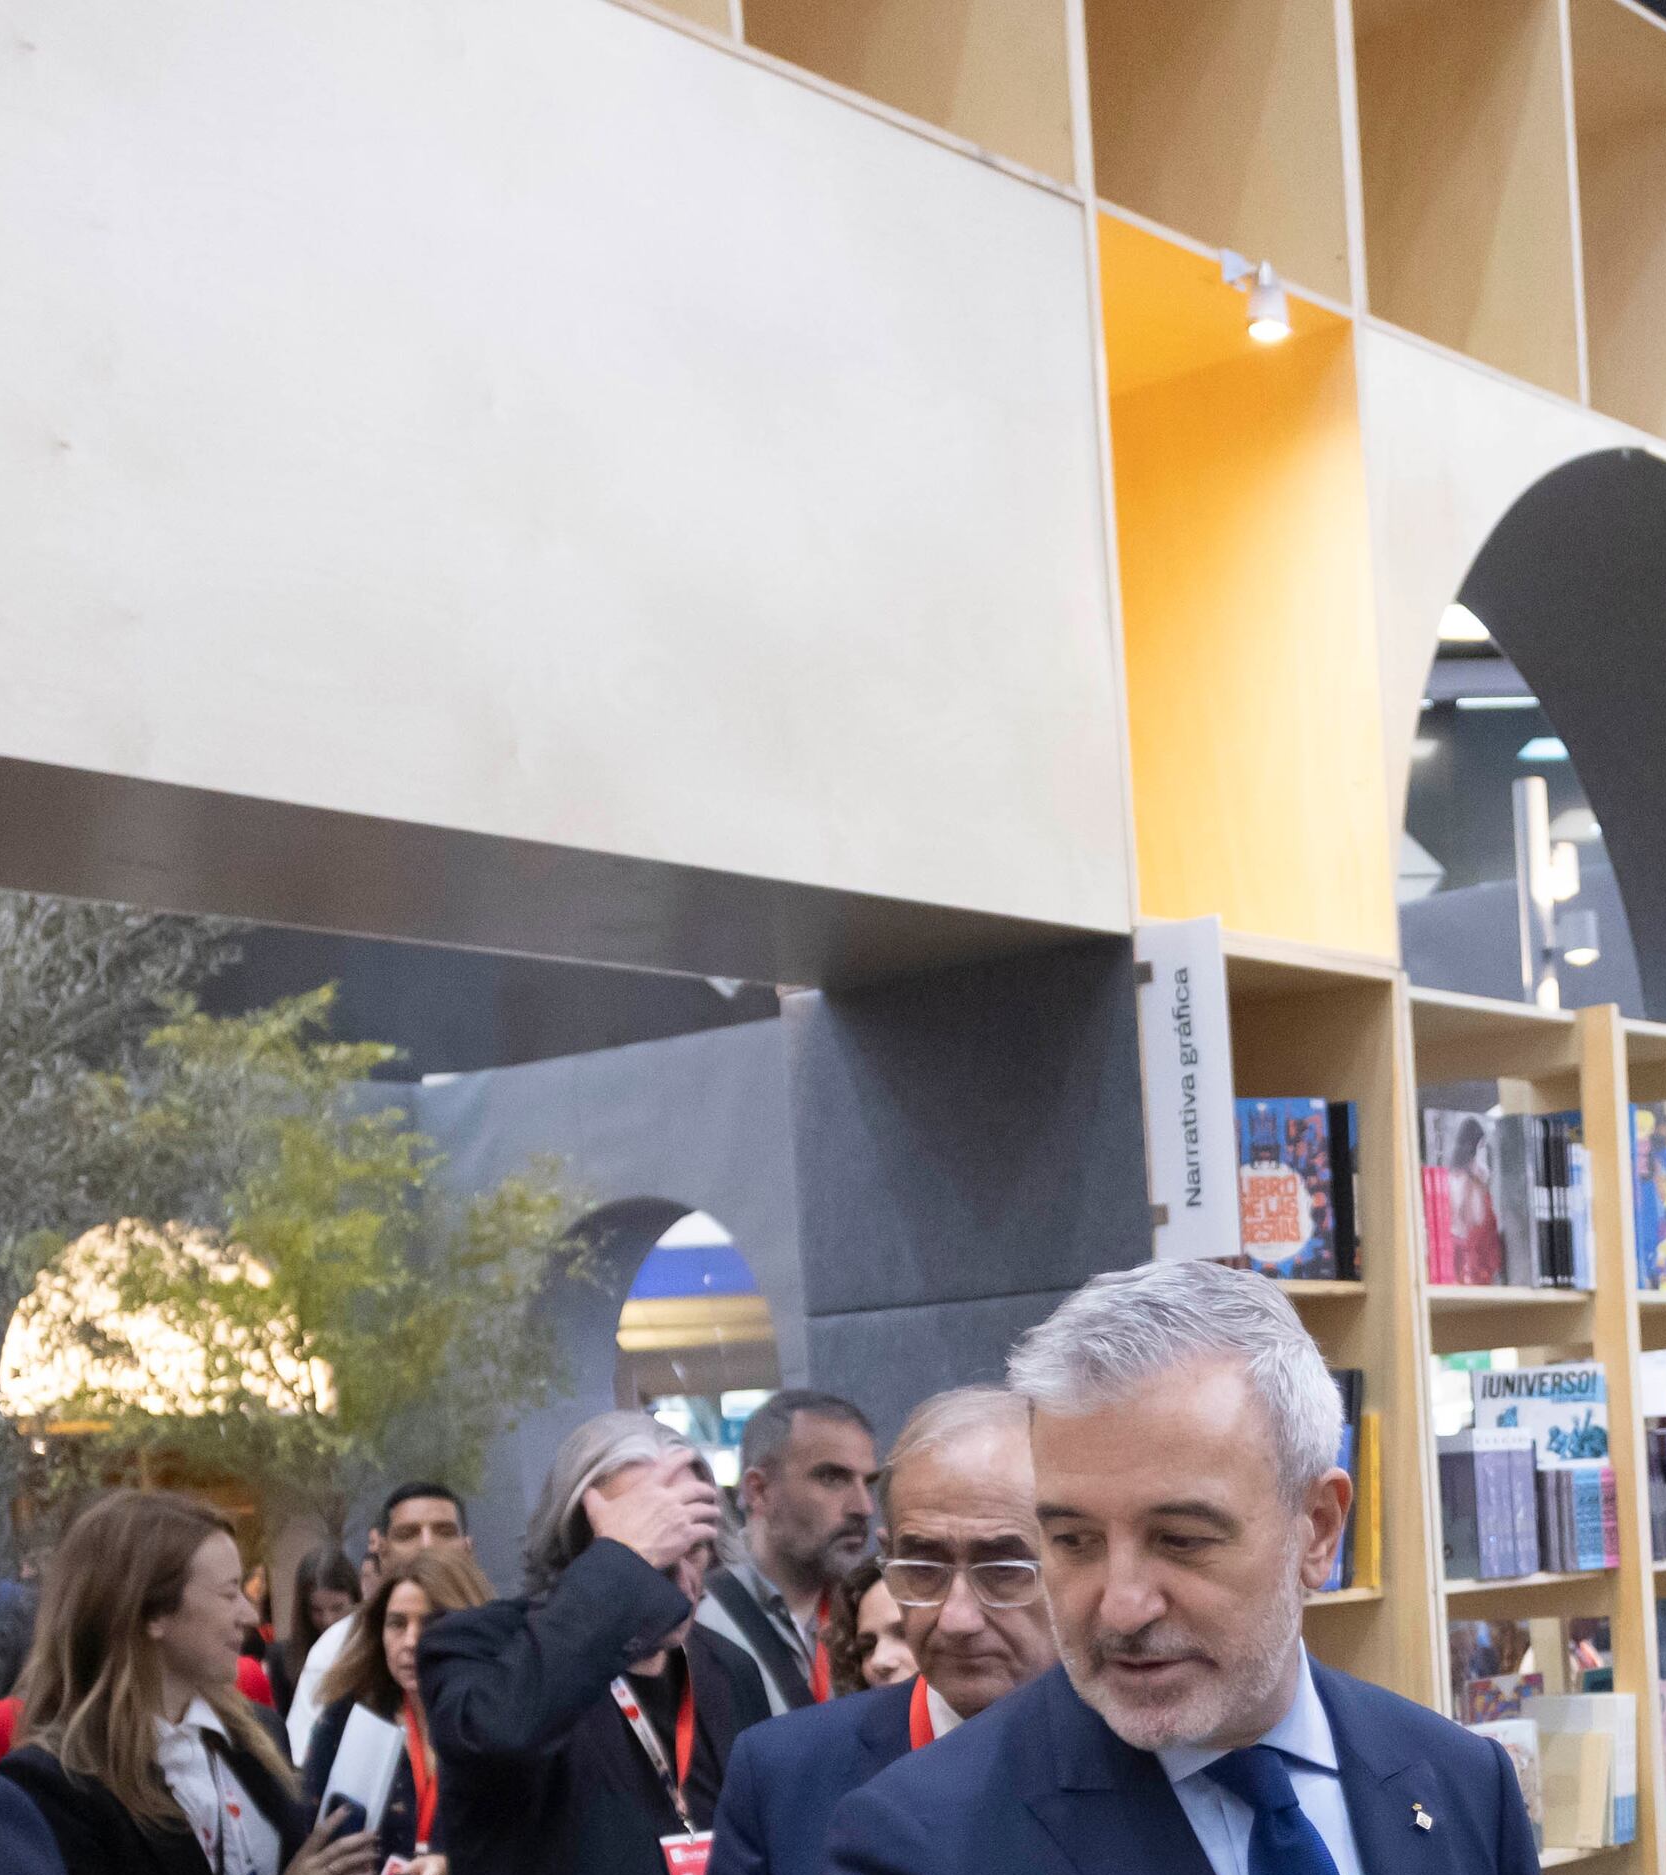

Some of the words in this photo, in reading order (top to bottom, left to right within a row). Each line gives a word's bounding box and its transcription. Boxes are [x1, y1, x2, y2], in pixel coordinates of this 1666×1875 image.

[1171, 966, 1199, 1067] gráfica
[1178, 1074, 1202, 1209] Narrativa
[1481, 1369, 1598, 1400] ¡UNIVERSO!
